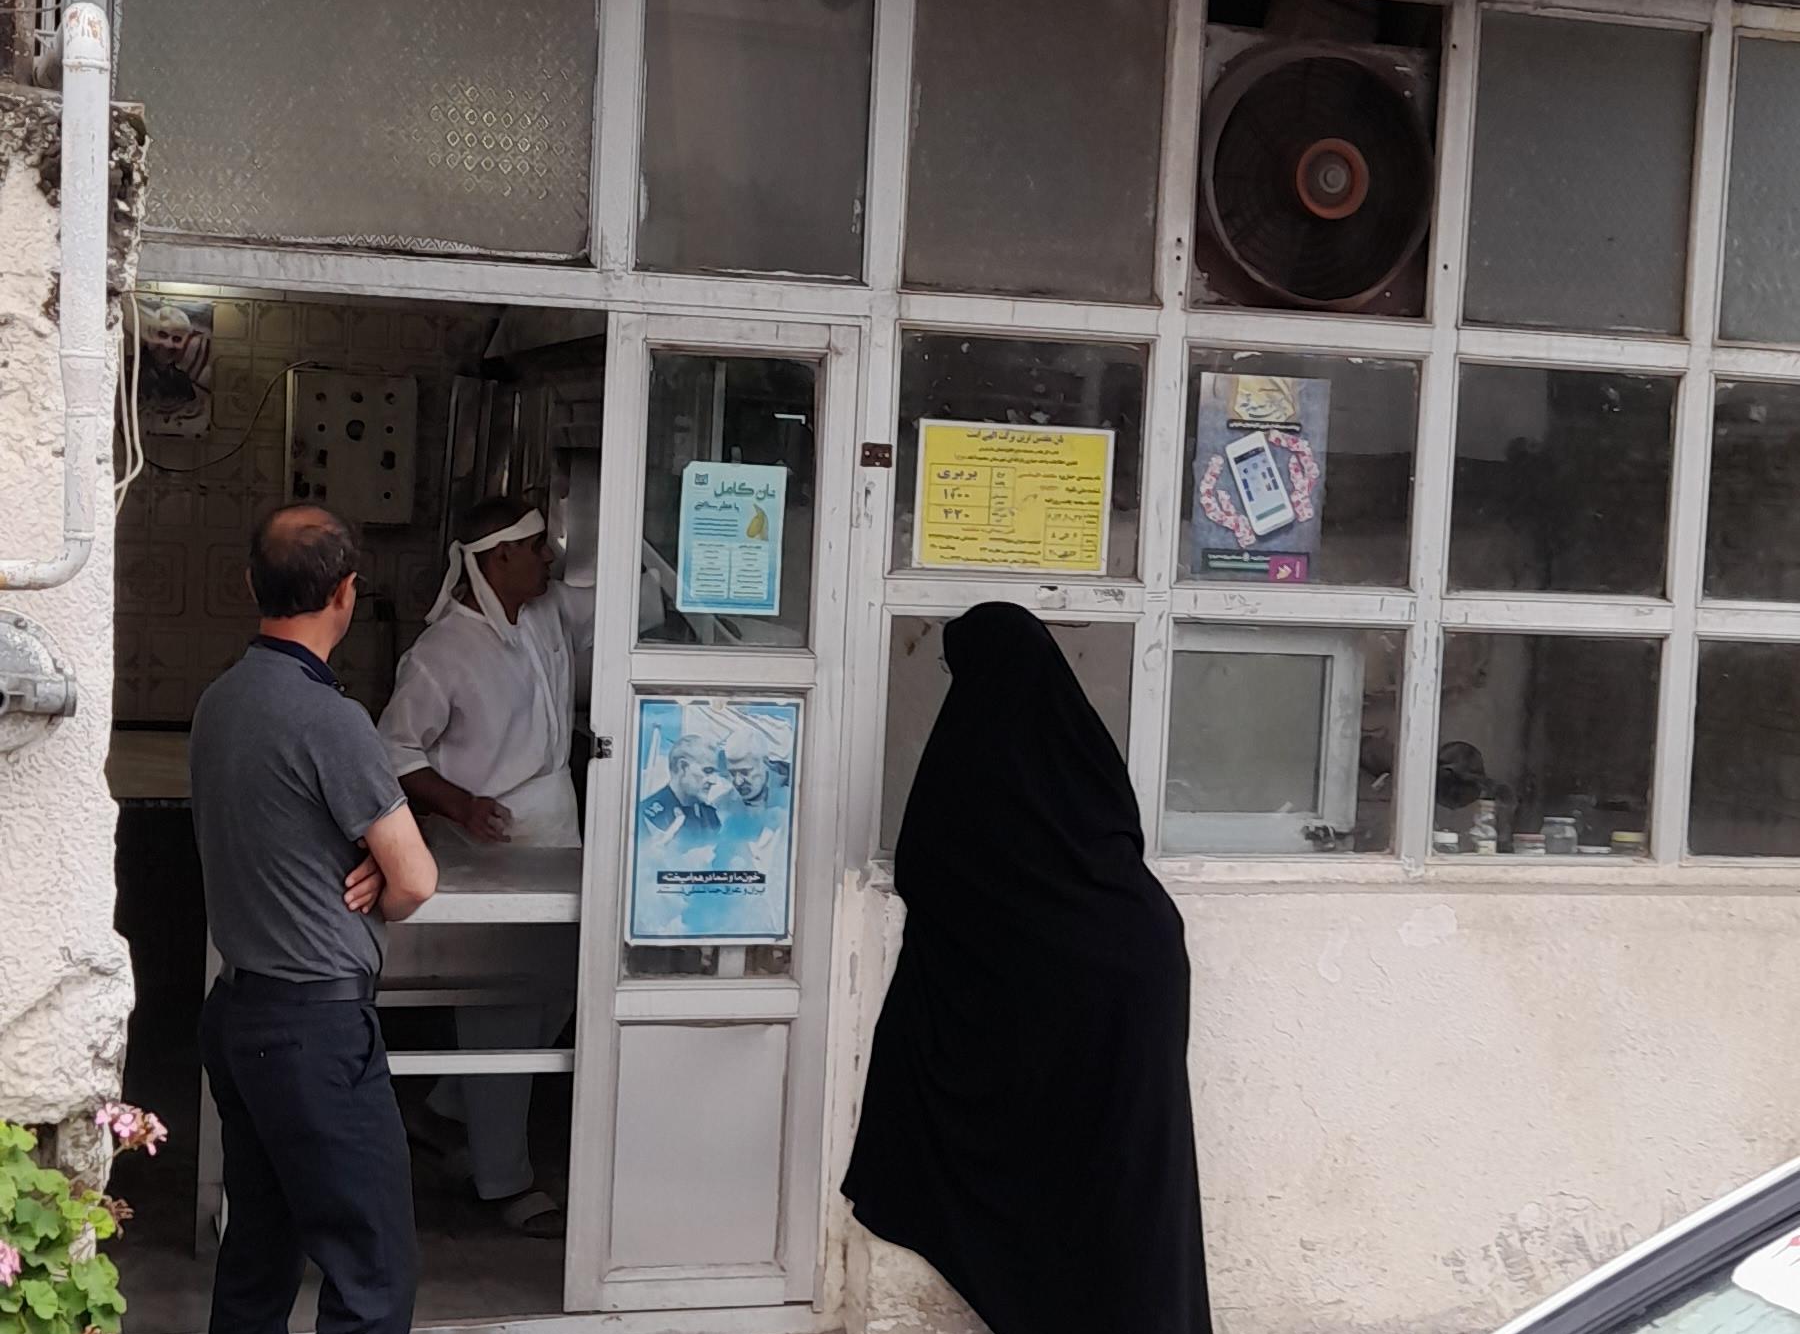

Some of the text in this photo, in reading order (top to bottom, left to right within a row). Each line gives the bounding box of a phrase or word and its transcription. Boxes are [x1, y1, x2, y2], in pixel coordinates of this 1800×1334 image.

[936, 469, 978, 481] بربری
[714, 480, 755, 498] کامل
[755, 483, 776, 500] نان
